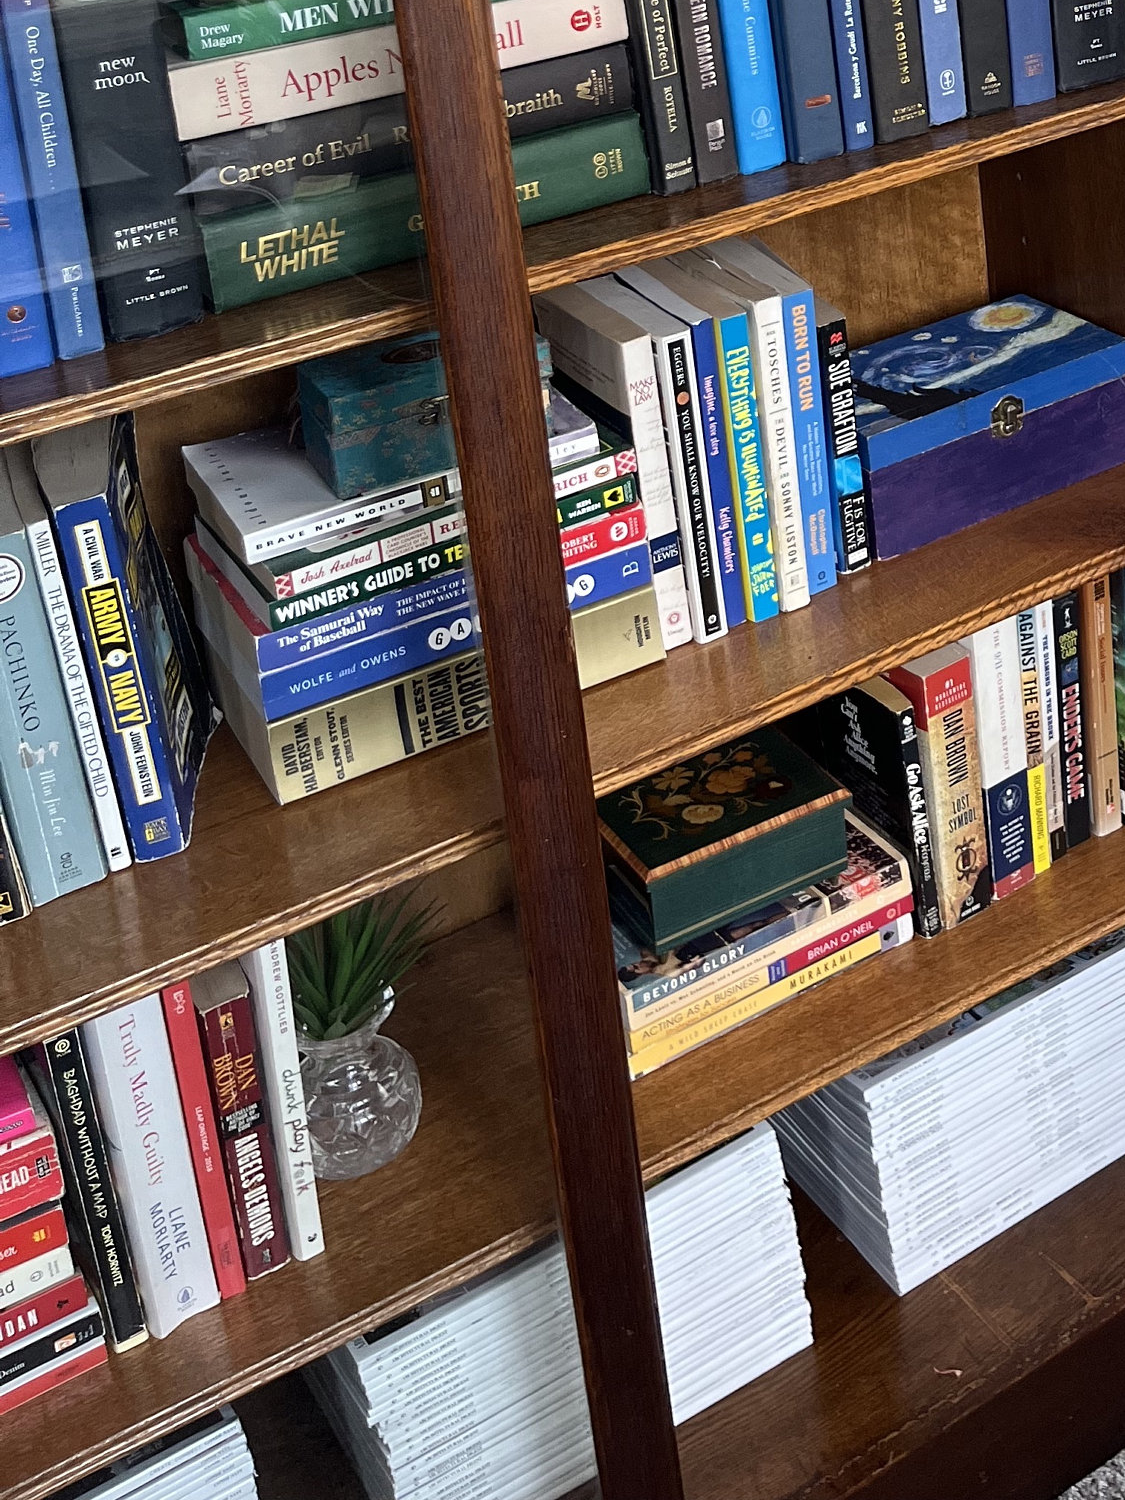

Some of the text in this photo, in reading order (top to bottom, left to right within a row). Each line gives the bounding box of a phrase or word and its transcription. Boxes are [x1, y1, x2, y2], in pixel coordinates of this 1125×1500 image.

[200, 23, 231, 37] Drew
[1074, 0, 1113, 13] STEPHENIE
[1074, 6, 1113, 23] MEYER
[99, 56, 136, 73] new
[201, 33, 245, 50] Magary
[694, 26, 717, 90] ROMANCE
[745, 16, 760, 75] Cummins
[25, 26, 58, 168] One Day, All Children
[94, 71, 151, 90] moon
[215, 76, 232, 119] Liane
[233, 60, 255, 126] Moriarty
[281, 56, 381, 101] Apples
[663, 86, 679, 133] ROTELLA
[219, 156, 297, 186] Career
[302, 144, 325, 168] of
[328, 133, 373, 161] Evil
[114, 217, 178, 238] STEPHENIE
[116, 228, 180, 250] MEYER
[240, 218, 346, 263] LETHAL
[254, 240, 339, 282] WHITE
[791, 304, 807, 347] BORN
[768, 339, 783, 405] TOSCHES
[796, 350, 811, 374] TO
[704, 375, 716, 415] Imagine,
[710, 436, 720, 456] story
[797, 376, 815, 412] RUN
[828, 359, 858, 456] SUE GRAFTON
[256, 498, 408, 551] BRAVE NEW WORLD
[568, 501, 601, 519] WARREN
[84, 537, 100, 560] CIVIL
[653, 548, 679, 564] LEWIS
[718, 506, 736, 574] Kelly Chambers
[90, 559, 105, 581] WAR
[275, 581, 361, 624] WINNER'S
[364, 561, 415, 593] GUIDE
[418, 553, 441, 574] TO
[300, 549, 373, 585] Josh Axelrad
[89, 588, 126, 645] ARMY
[396, 579, 460, 608] THE IMPACT OF
[397, 591, 460, 618] THE NEW WAVE
[277, 602, 385, 649] The Samurai Way
[299, 619, 366, 653] of Baseball
[1, 614, 41, 733] PACHINKO
[35, 531, 108, 798] MILLER THE DRAMA OF THE GIFTED CHILD
[289, 646, 407, 694] WOLFE and OWENS
[994, 651, 1002, 670] 9/11
[1019, 613, 1042, 755] AGAINST THE GRAIN
[1043, 653, 1051, 687] DIAMOND
[108, 669, 144, 724] NAVY
[412, 678, 432, 748] THE BEST
[427, 666, 460, 743] AMERICAN
[995, 671, 1007, 733] COMMISSION
[129, 731, 154, 798] JOHN FEINSTEIN
[282, 743, 299, 776] DAVID
[943, 708, 969, 788] DAN BROWN
[1002, 734, 1011, 771] REPORT
[1061, 683, 1085, 804] ENDER'S GAME
[948, 808, 978, 833] SYMBOL
[952, 794, 970, 815] LOST
[1034, 775, 1045, 841] RICHARD MANNING
[807, 920, 875, 961] BRIAN O'NEIL
[642, 969, 697, 1002] BEYOND
[703, 944, 745, 974] GLORY
[789, 949, 854, 990] MURAKAMI
[213, 1052, 238, 1111] BROWN
[235, 1053, 258, 1092] DAN
[118, 1014, 165, 1187] Truly Madly Guilty
[63, 1068, 126, 1287] BAGHDAD WITHOUT A MAP TONY HORWITZ
[234, 1133, 266, 1189] ANGELS
[168, 1206, 191, 1255] LIANE
[244, 1184, 275, 1247] DEMONS
[149, 1201, 178, 1281] MORIARTY
